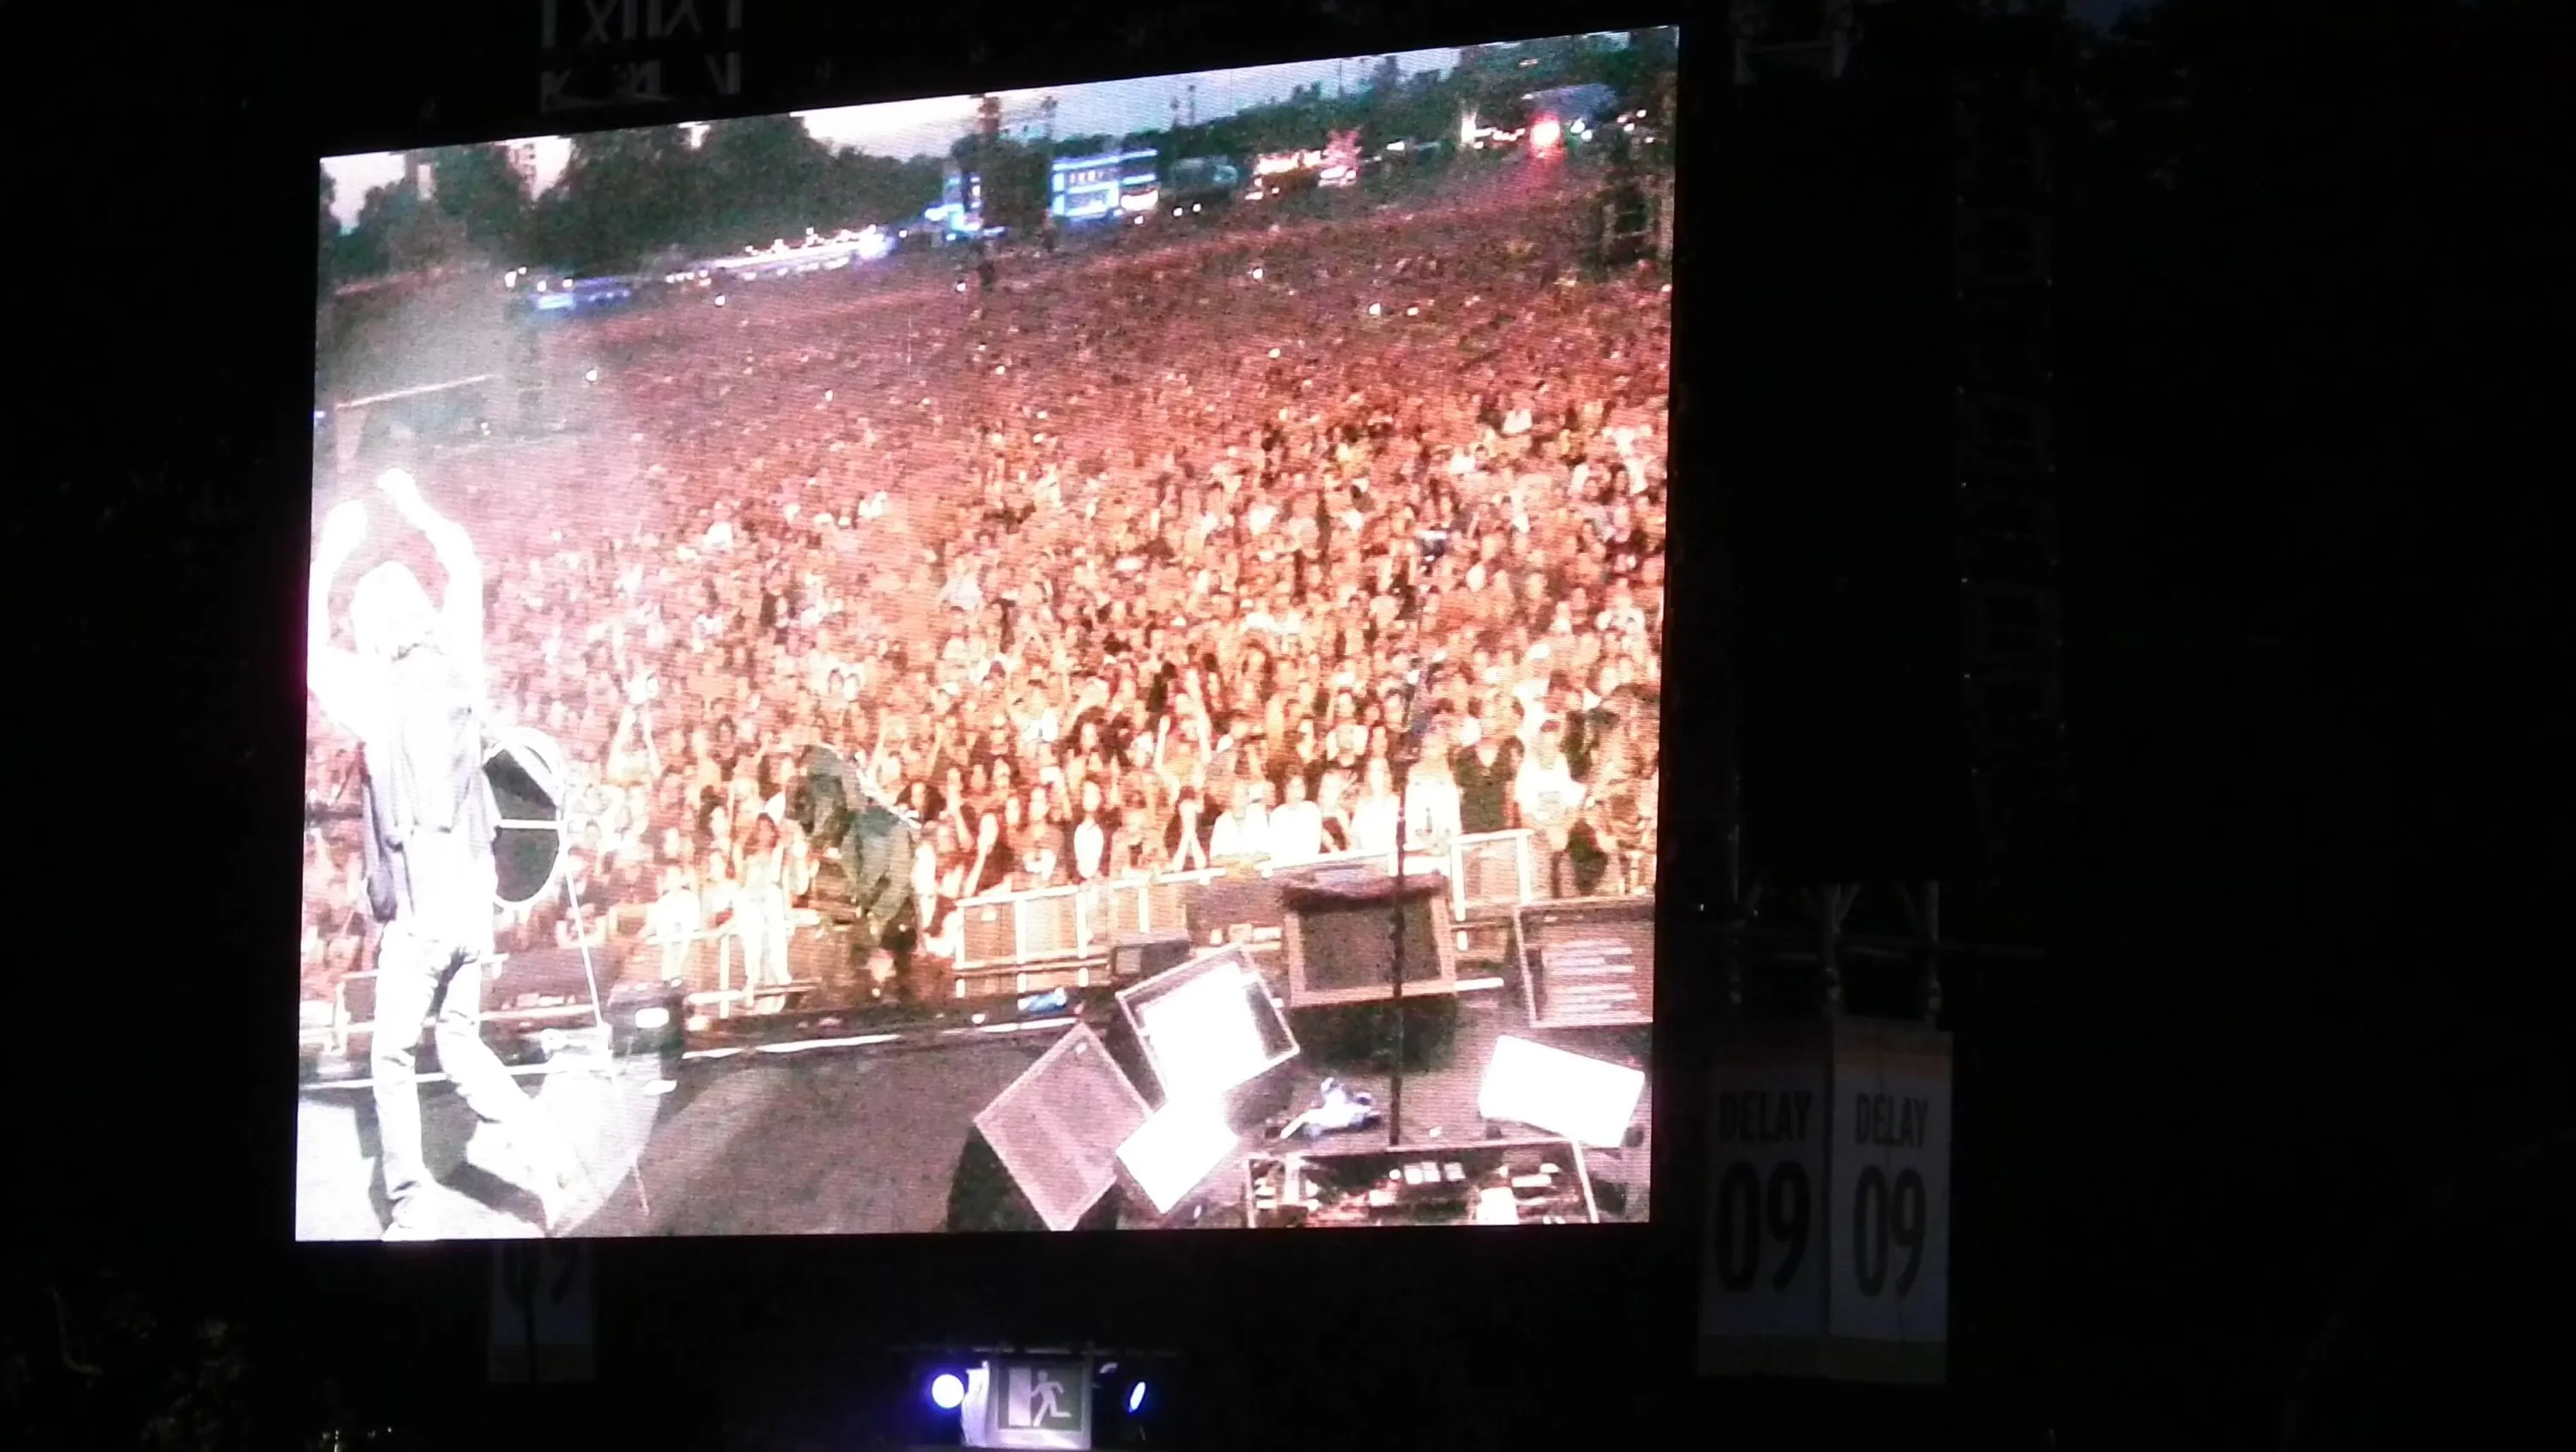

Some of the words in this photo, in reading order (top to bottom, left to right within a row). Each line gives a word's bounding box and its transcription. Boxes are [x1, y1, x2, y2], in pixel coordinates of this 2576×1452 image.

[1719, 1090, 1813, 1144] DELAY
[1856, 1092, 1929, 1148] DELAY
[1716, 1159, 1810, 1294] 09
[1854, 1163, 1926, 1297] 09
